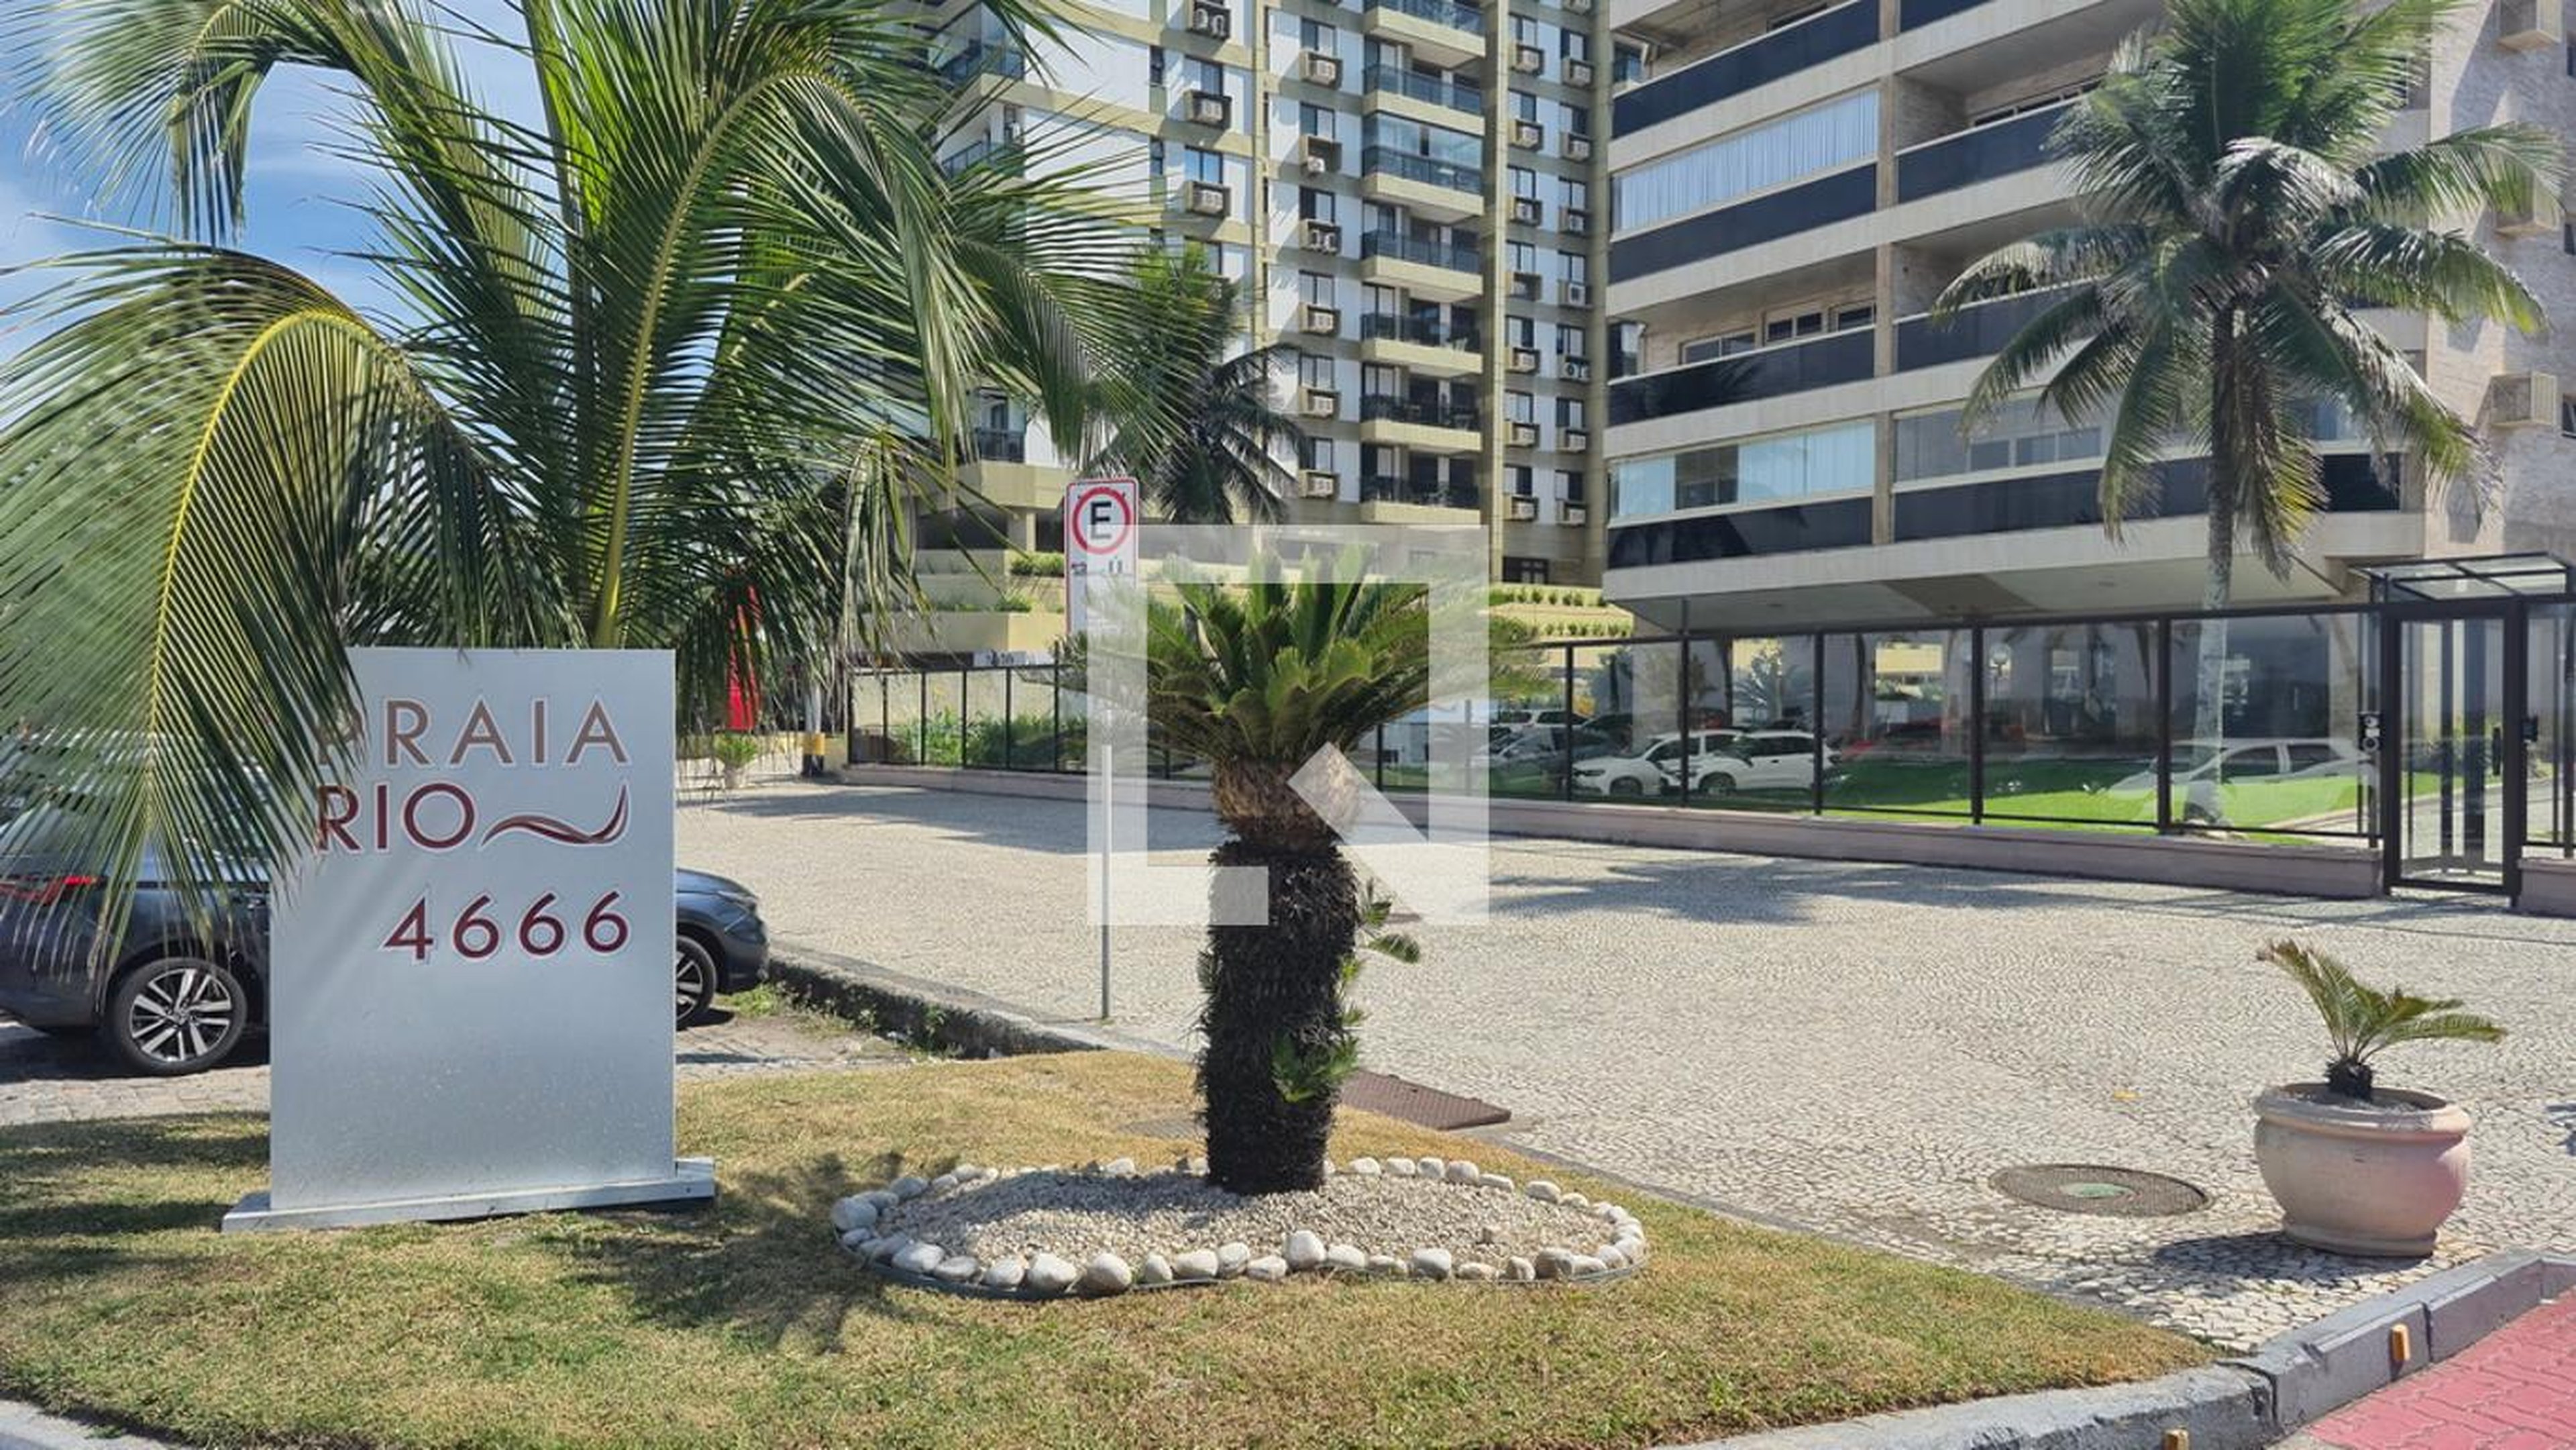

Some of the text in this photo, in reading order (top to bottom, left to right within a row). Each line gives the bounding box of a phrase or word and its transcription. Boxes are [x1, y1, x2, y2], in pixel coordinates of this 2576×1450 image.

[1090, 501, 1112, 539] E
[317, 783, 475, 850] RIO
[383, 890, 629, 961] 4666
